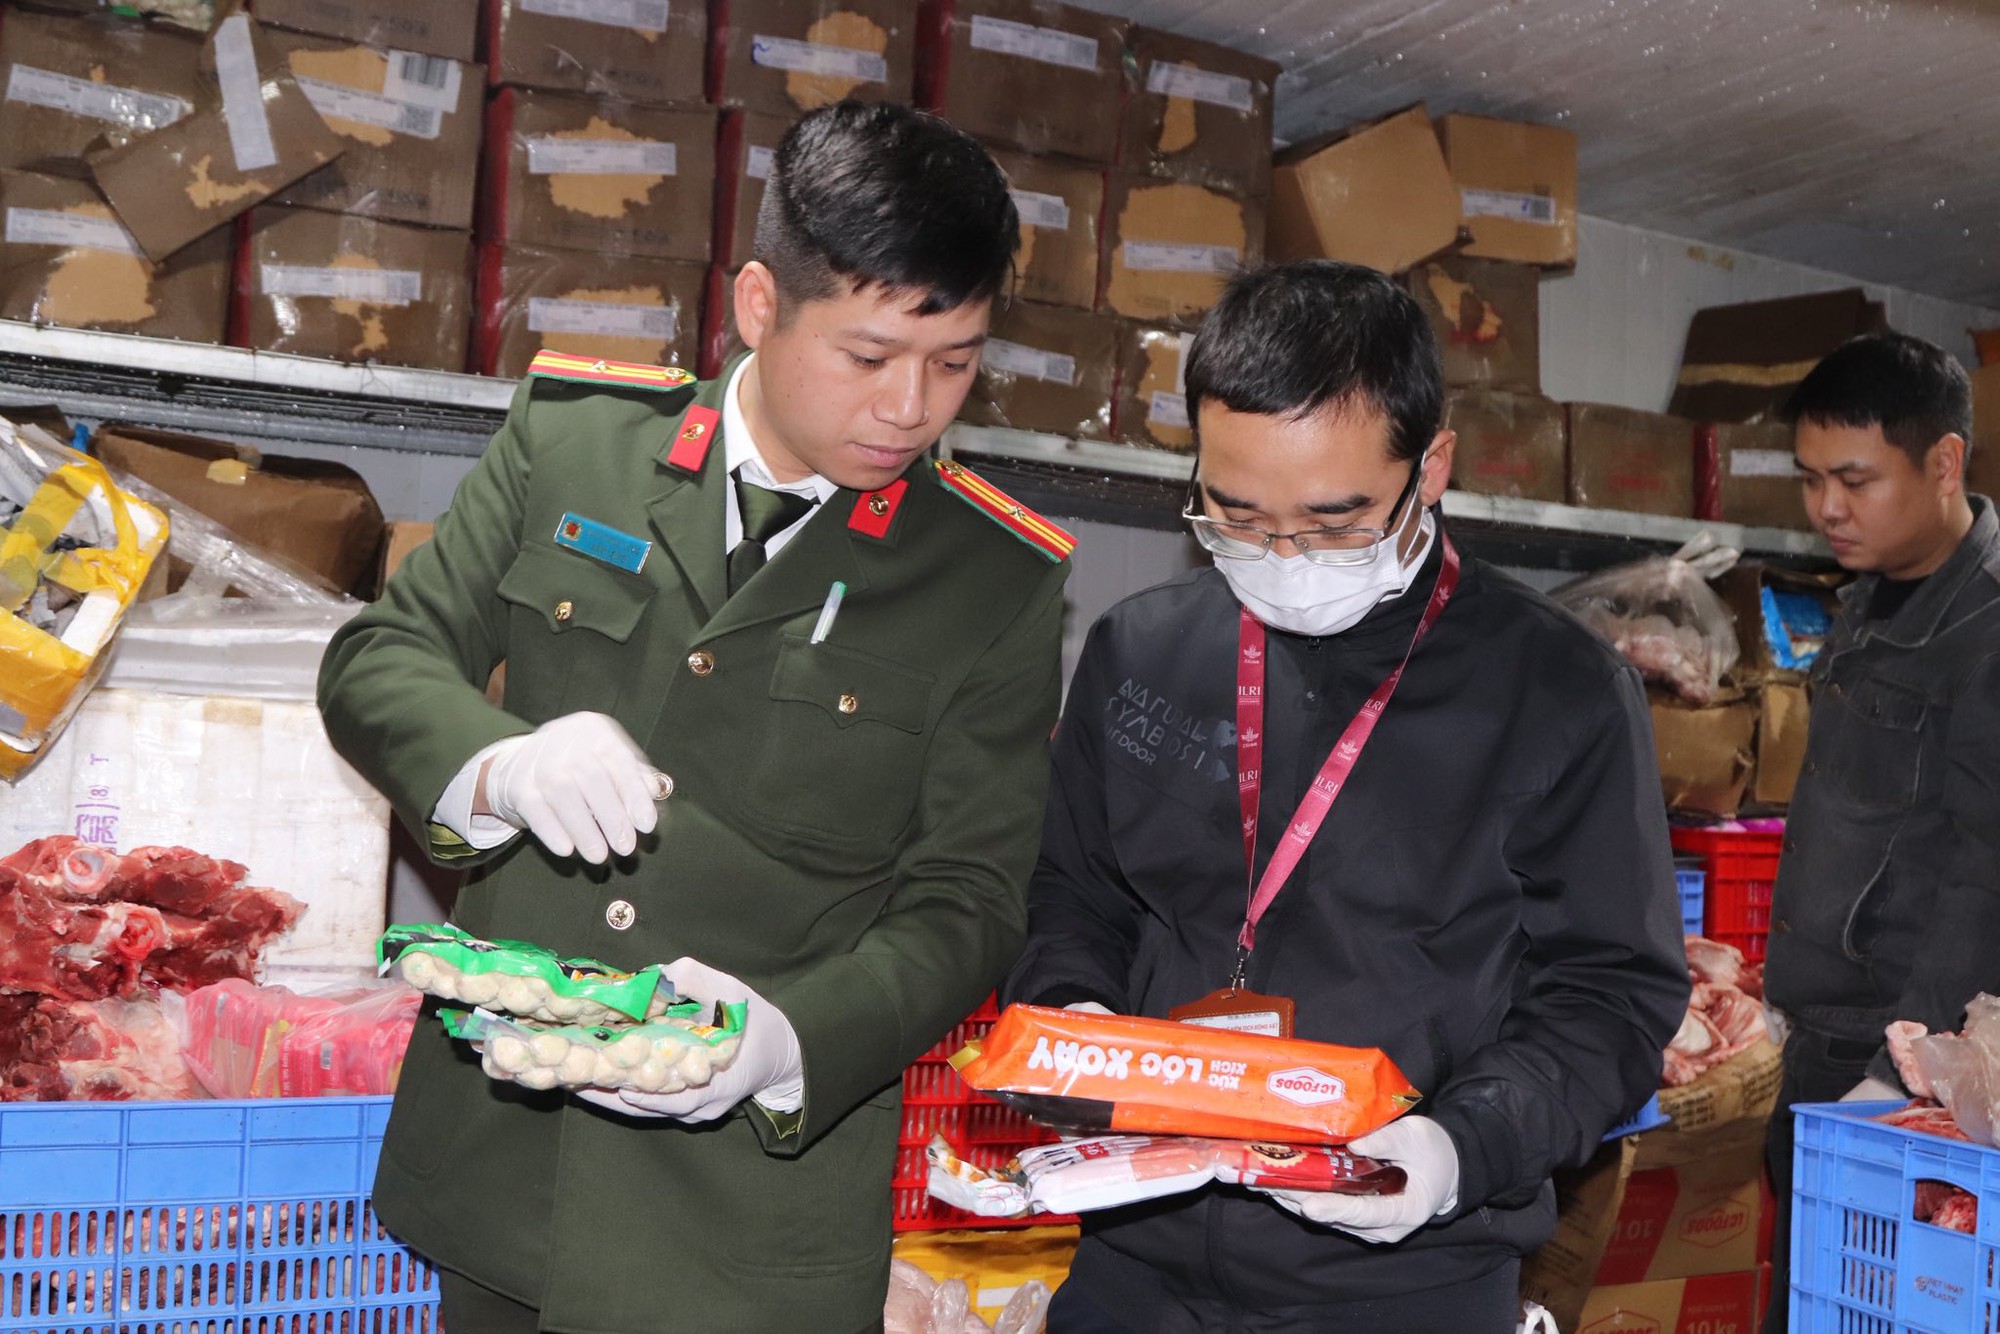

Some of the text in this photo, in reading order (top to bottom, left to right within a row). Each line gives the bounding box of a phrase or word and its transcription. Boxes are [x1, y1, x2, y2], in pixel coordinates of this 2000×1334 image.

[1238, 685, 1261, 696] ILRI
[1364, 698, 1384, 712] ILRI
[1238, 769, 1259, 783] ILRI
[1314, 775, 1339, 794] ILRI
[1140, 1051, 1204, 1086] LỐC
[1687, 1320, 1710, 1334] 10
